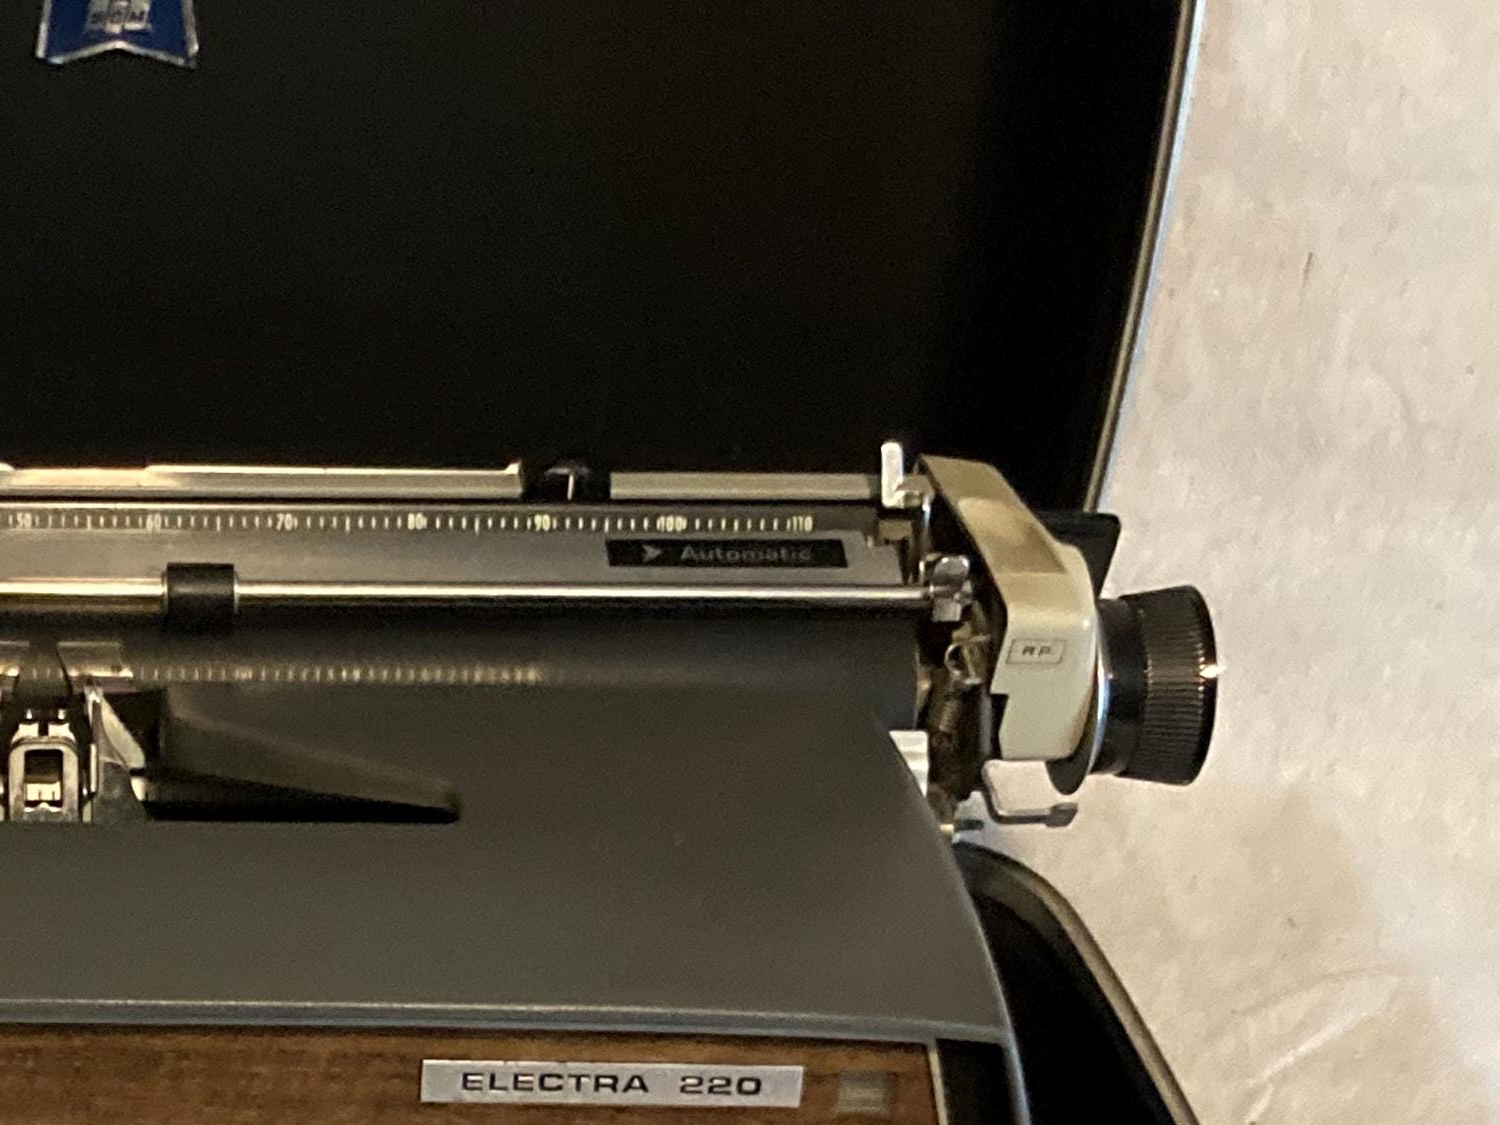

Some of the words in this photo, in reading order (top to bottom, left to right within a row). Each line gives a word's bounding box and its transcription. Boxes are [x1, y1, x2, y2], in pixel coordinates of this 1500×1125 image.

[17, 512, 32, 528] 50
[275, 513, 292, 530] 70
[534, 514, 550, 531] 90
[680, 545, 813, 561] Automatic
[461, 1072, 648, 1094] ELECTRA
[680, 1076, 763, 1096] 220
